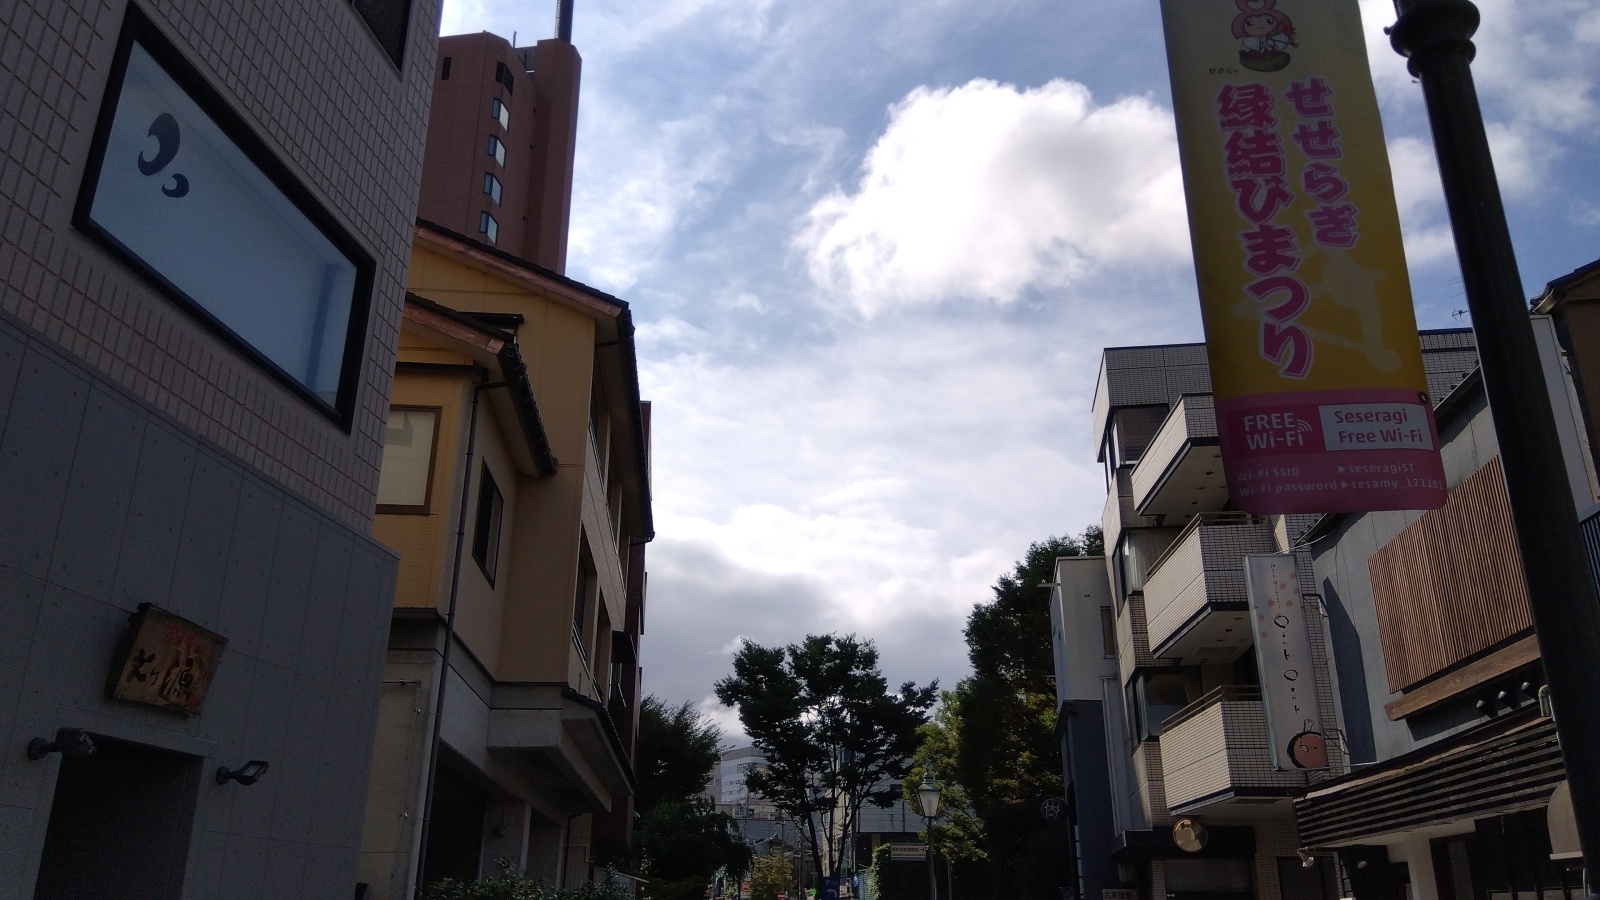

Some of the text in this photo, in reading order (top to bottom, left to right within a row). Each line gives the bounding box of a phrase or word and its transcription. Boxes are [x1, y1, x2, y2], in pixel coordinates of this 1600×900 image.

[1284, 76, 1358, 248] せせらぎ
[1216, 83, 1313, 380] 縁結びまつり
[1244, 412, 1295, 431] FREE
[1334, 408, 1408, 425] Seseragi
[1247, 430, 1303, 450] Wi-Fi
[1338, 427, 1423, 444] Free Wi-Fi
[1236, 468, 1271, 482] Wi-Fi
[1273, 467, 1299, 476] SSID
[1238, 483, 1272, 497] Wi-Fi
[1276, 480, 1337, 495] password
